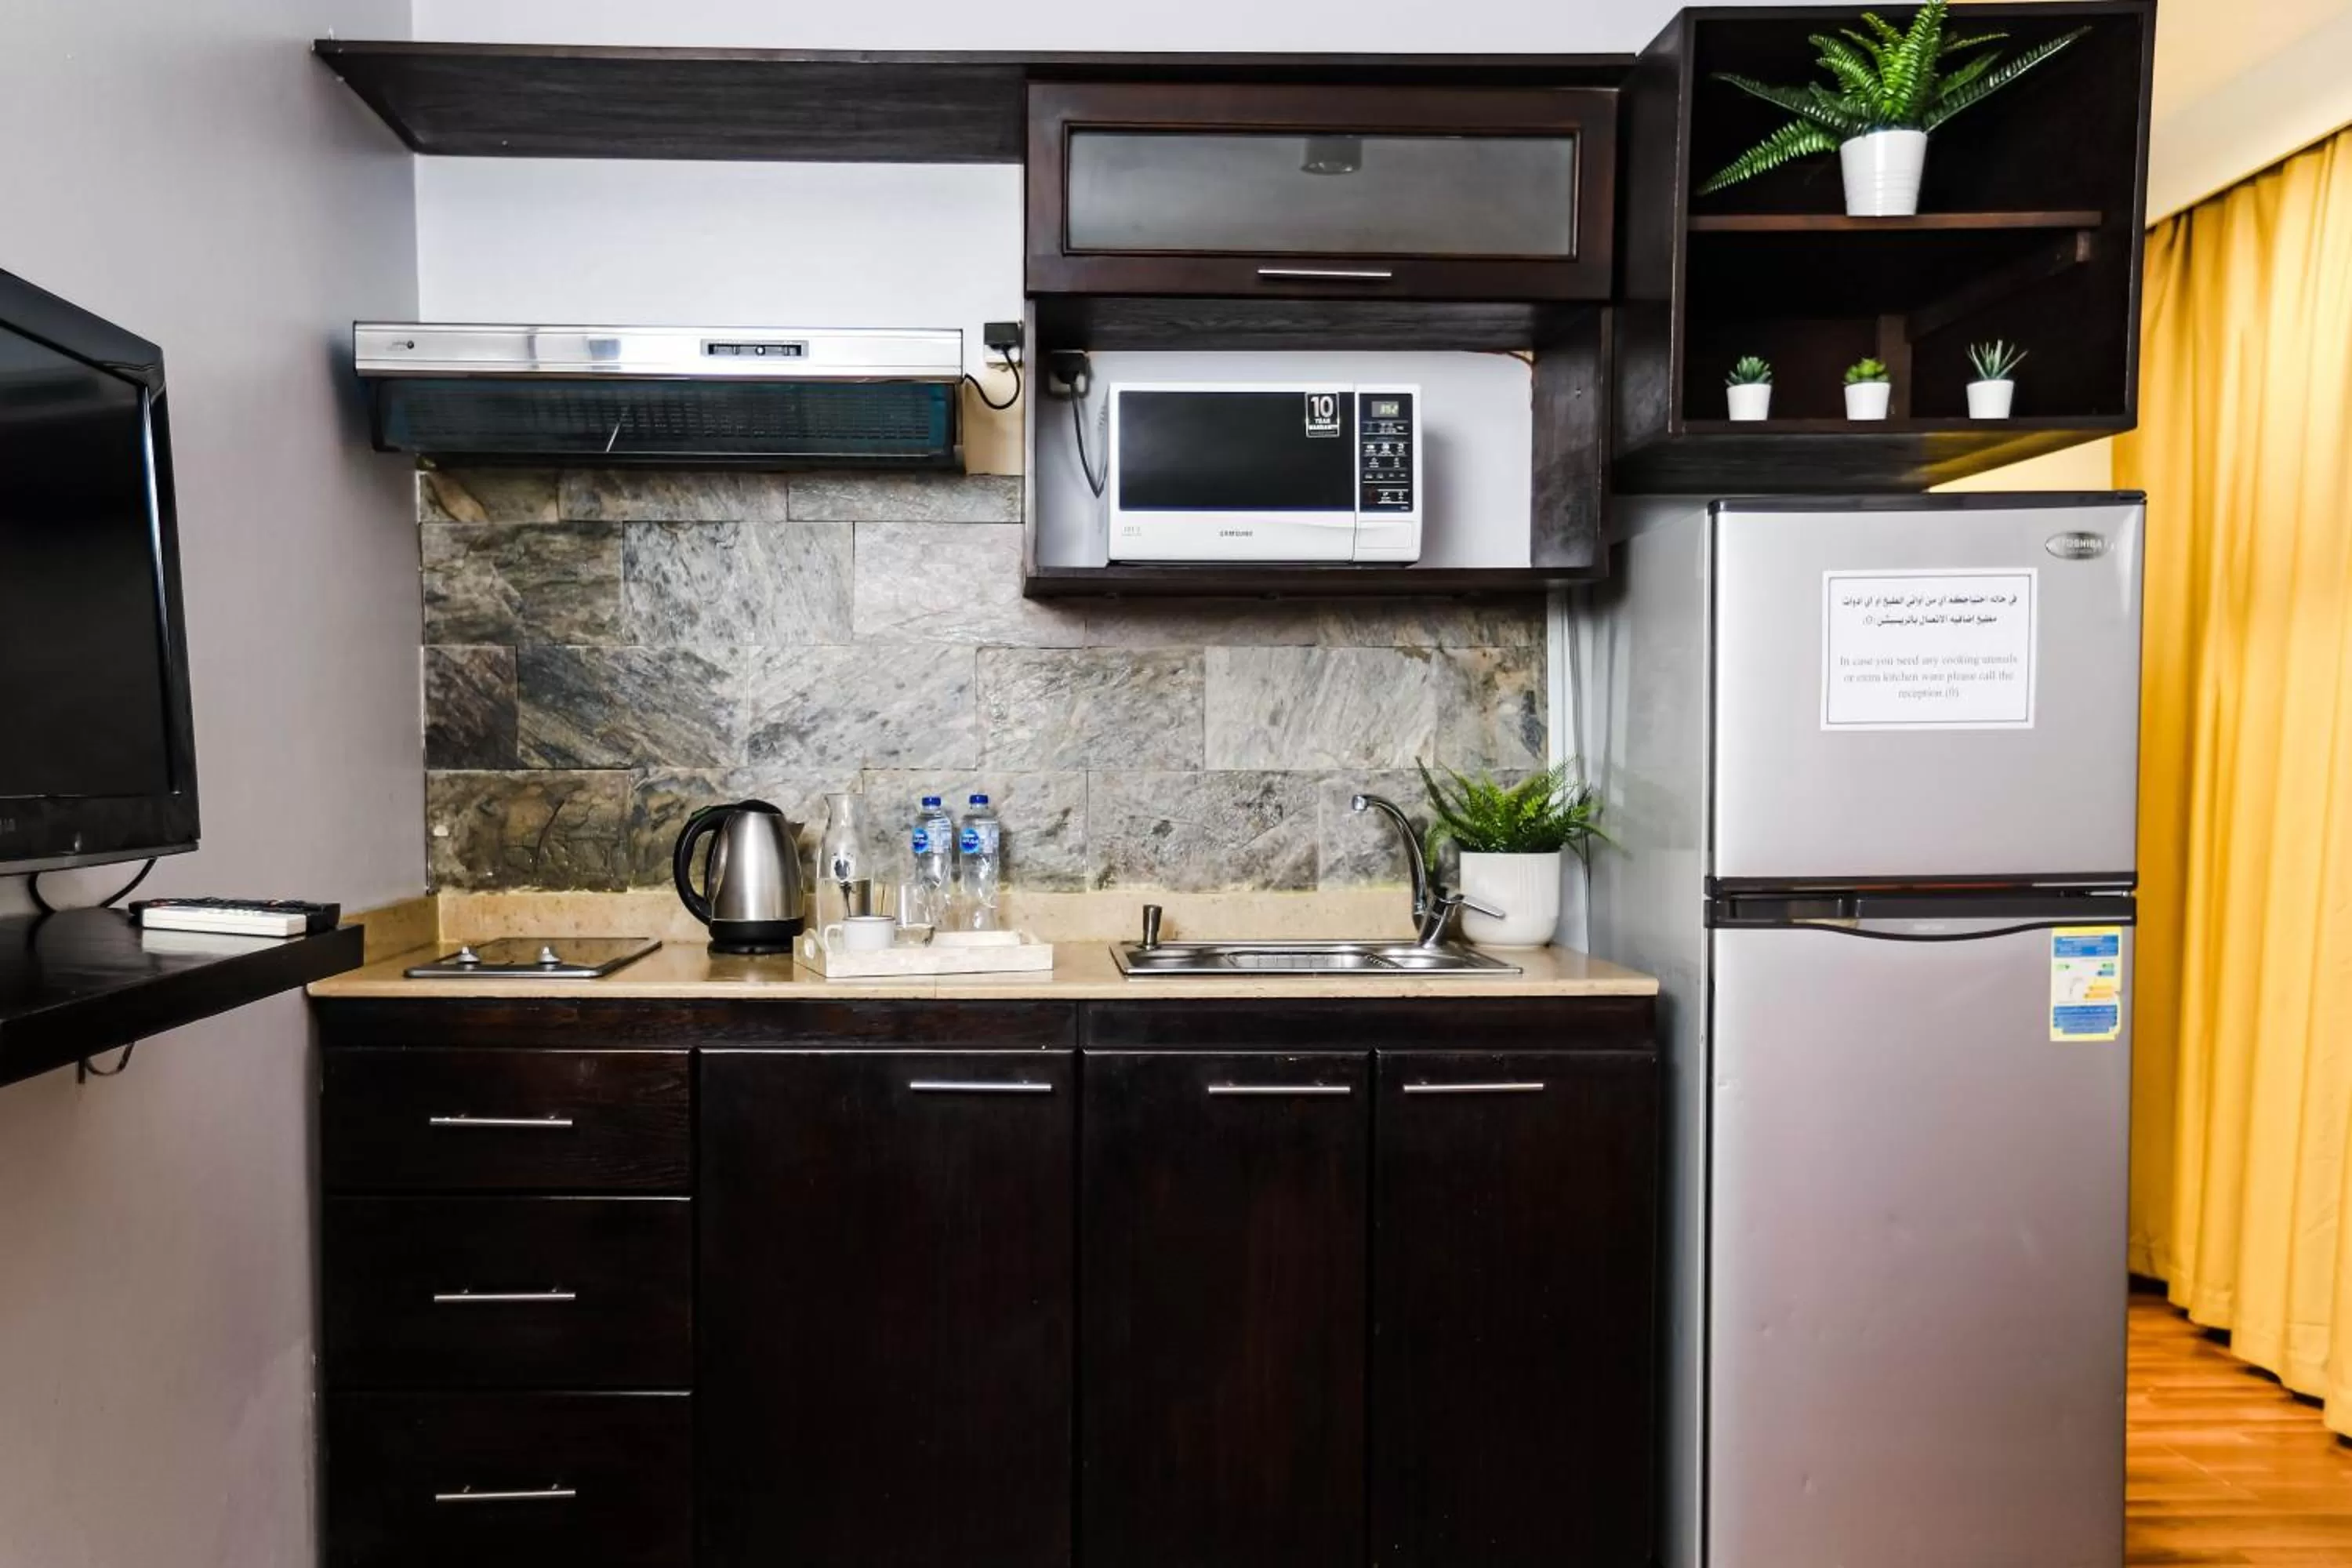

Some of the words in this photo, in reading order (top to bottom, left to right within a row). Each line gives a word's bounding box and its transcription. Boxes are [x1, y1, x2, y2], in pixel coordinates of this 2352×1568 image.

[1310, 395, 1334, 418] 10
[1840, 655, 1850, 666] In
[1853, 657, 1873, 666] case
[1875, 658, 1894, 670] you
[1896, 655, 1918, 666] need
[1921, 657, 1938, 669] any
[1941, 655, 1980, 668] cooking
[1843, 673, 1855, 682] or
[1857, 673, 1882, 682] extra
[1883, 671, 1918, 682] kitchen
[1921, 673, 1944, 681] ware
[1946, 671, 1976, 684] please
[1979, 670, 1996, 681] call
[1998, 670, 2014, 681] the
